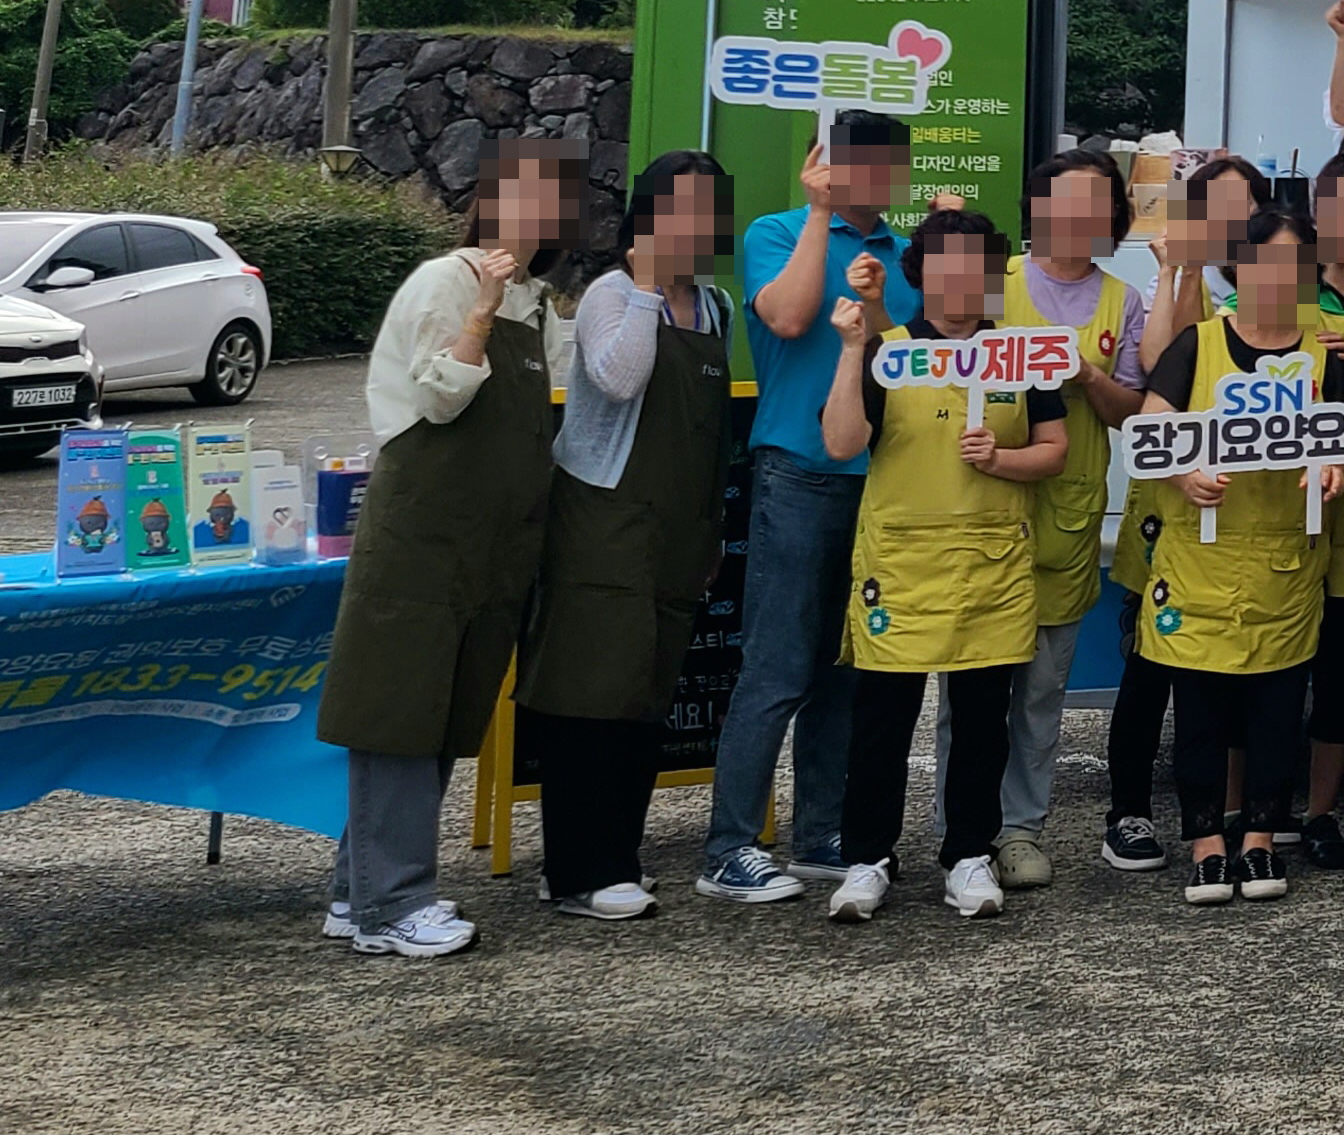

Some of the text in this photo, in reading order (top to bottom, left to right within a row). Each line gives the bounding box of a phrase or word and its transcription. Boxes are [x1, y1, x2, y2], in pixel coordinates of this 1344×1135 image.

[763, 7, 788, 30] 참
[953, 99, 1011, 115] 운영하는
[912, 155, 1002, 173] 디자인 사업을
[48, 387, 73, 402] 1032
[1222, 378, 1304, 416] SSN
